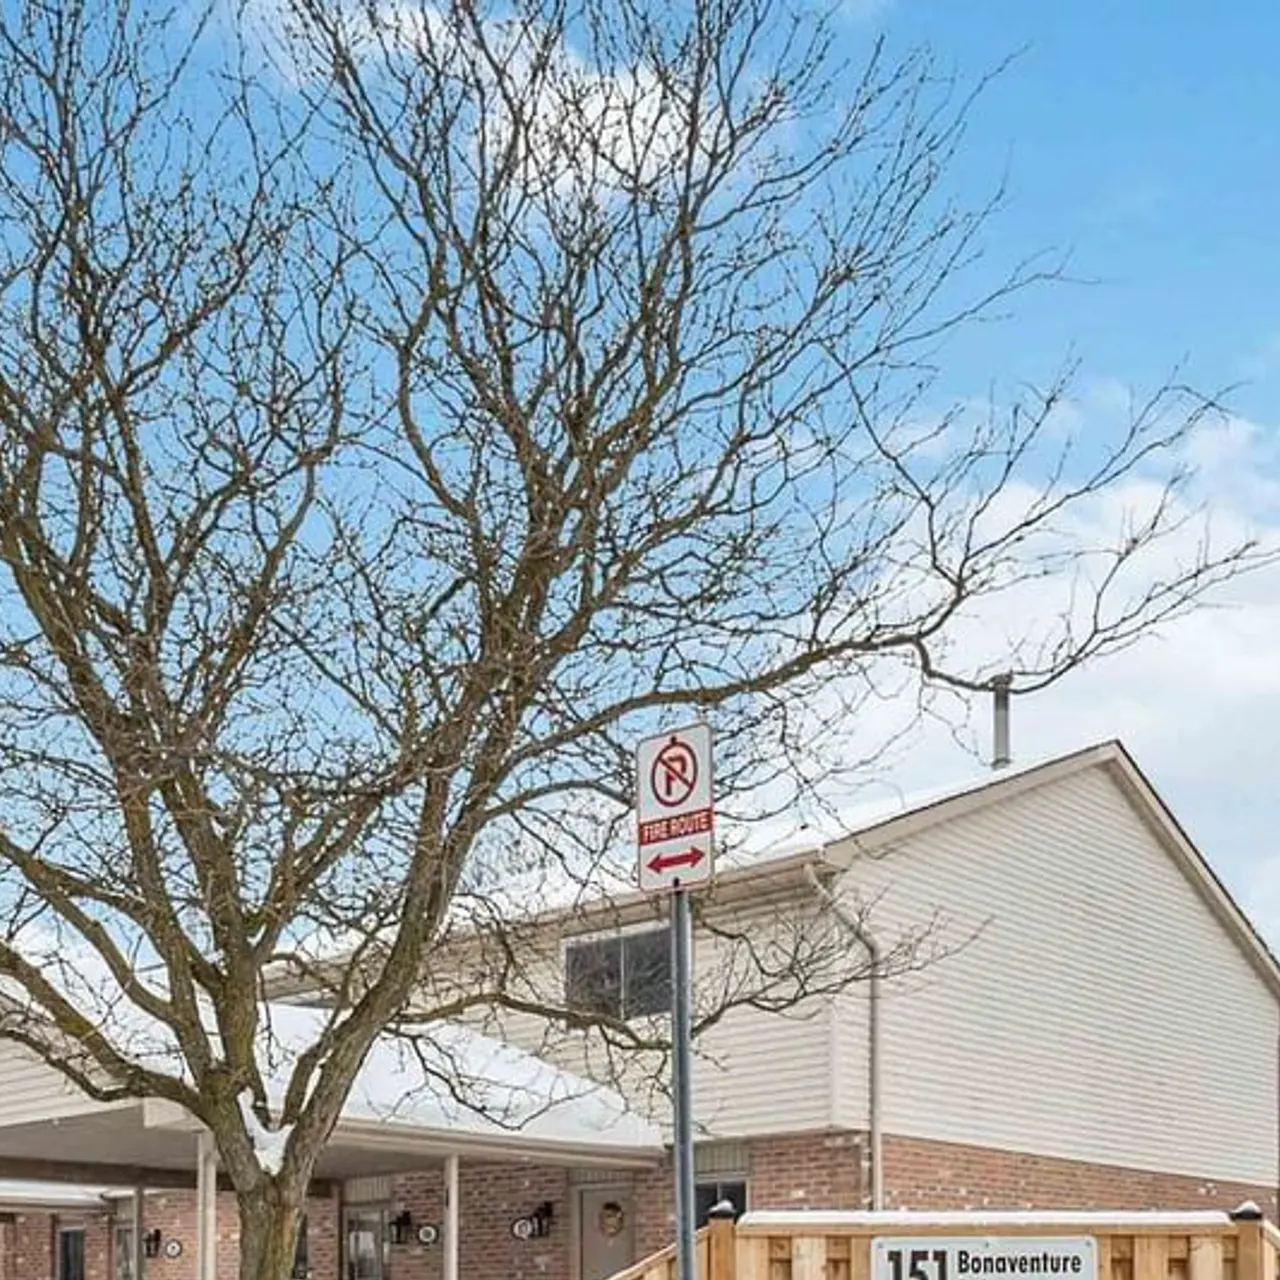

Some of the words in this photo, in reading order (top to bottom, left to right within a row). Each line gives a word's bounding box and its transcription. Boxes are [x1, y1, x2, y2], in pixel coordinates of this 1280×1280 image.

[642, 820, 668, 843] FIRE
[670, 811, 709, 836] ROUTE
[958, 1251, 1082, 1274] Bonaventure
